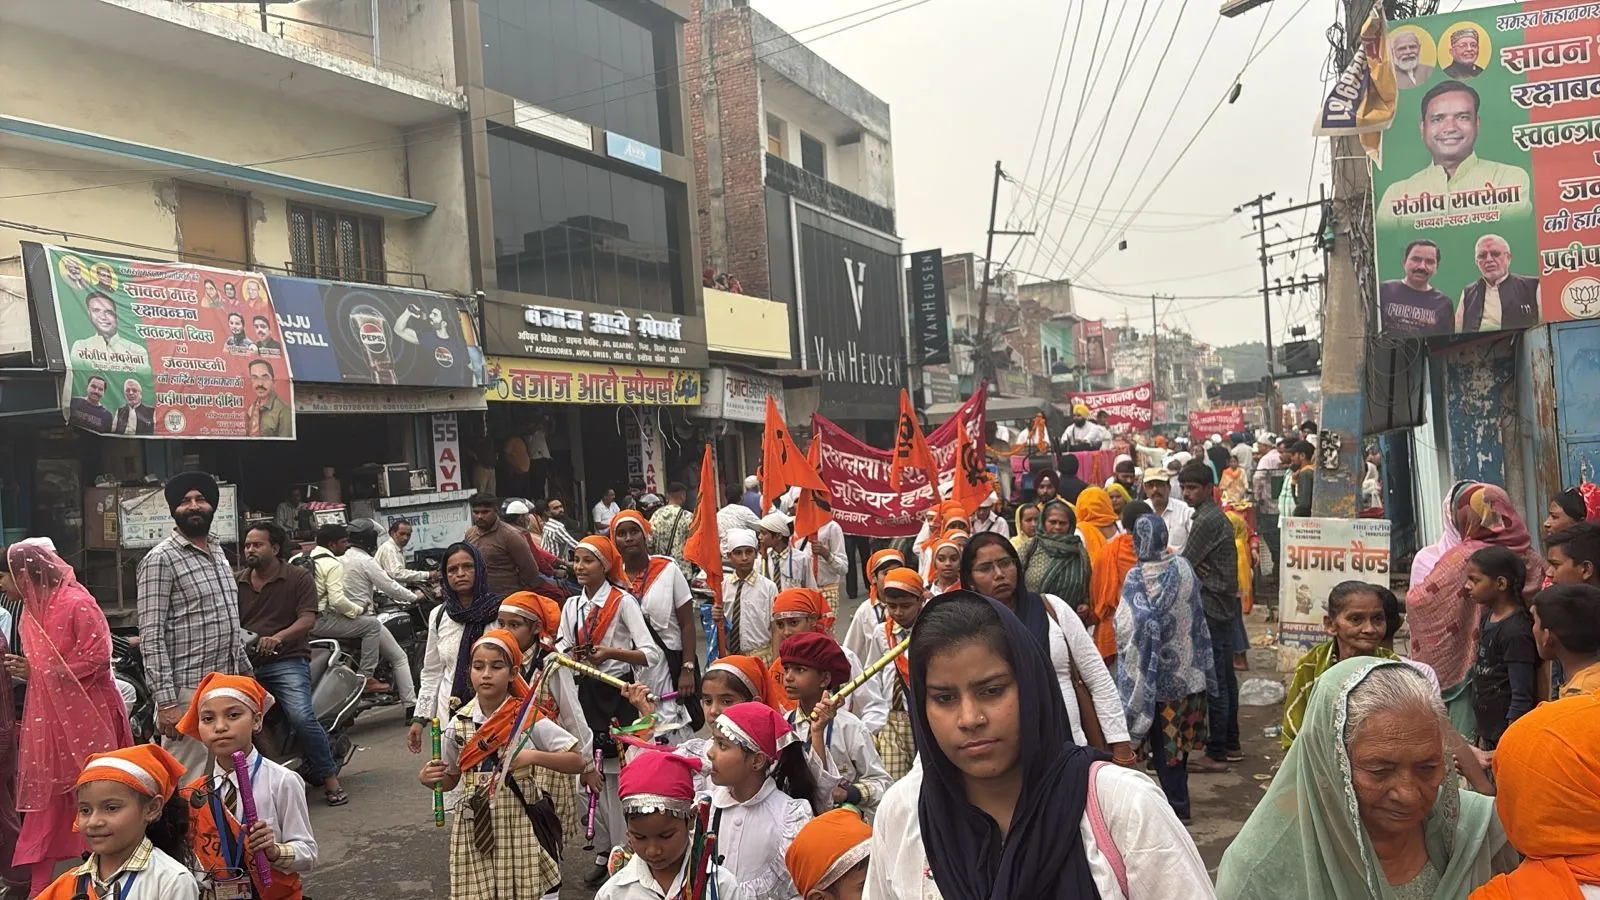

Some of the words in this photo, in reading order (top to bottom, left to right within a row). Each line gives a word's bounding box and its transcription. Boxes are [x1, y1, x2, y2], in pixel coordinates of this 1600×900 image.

[1501, 37, 1592, 72] सावन
[1391, 191, 1446, 216] संजीव
[1545, 208, 1569, 232] की
[284, 331, 329, 347] STALL
[361, 333, 385, 343] PEPSI
[509, 368, 572, 400] बजाज
[1286, 545, 1346, 572] आजाद
